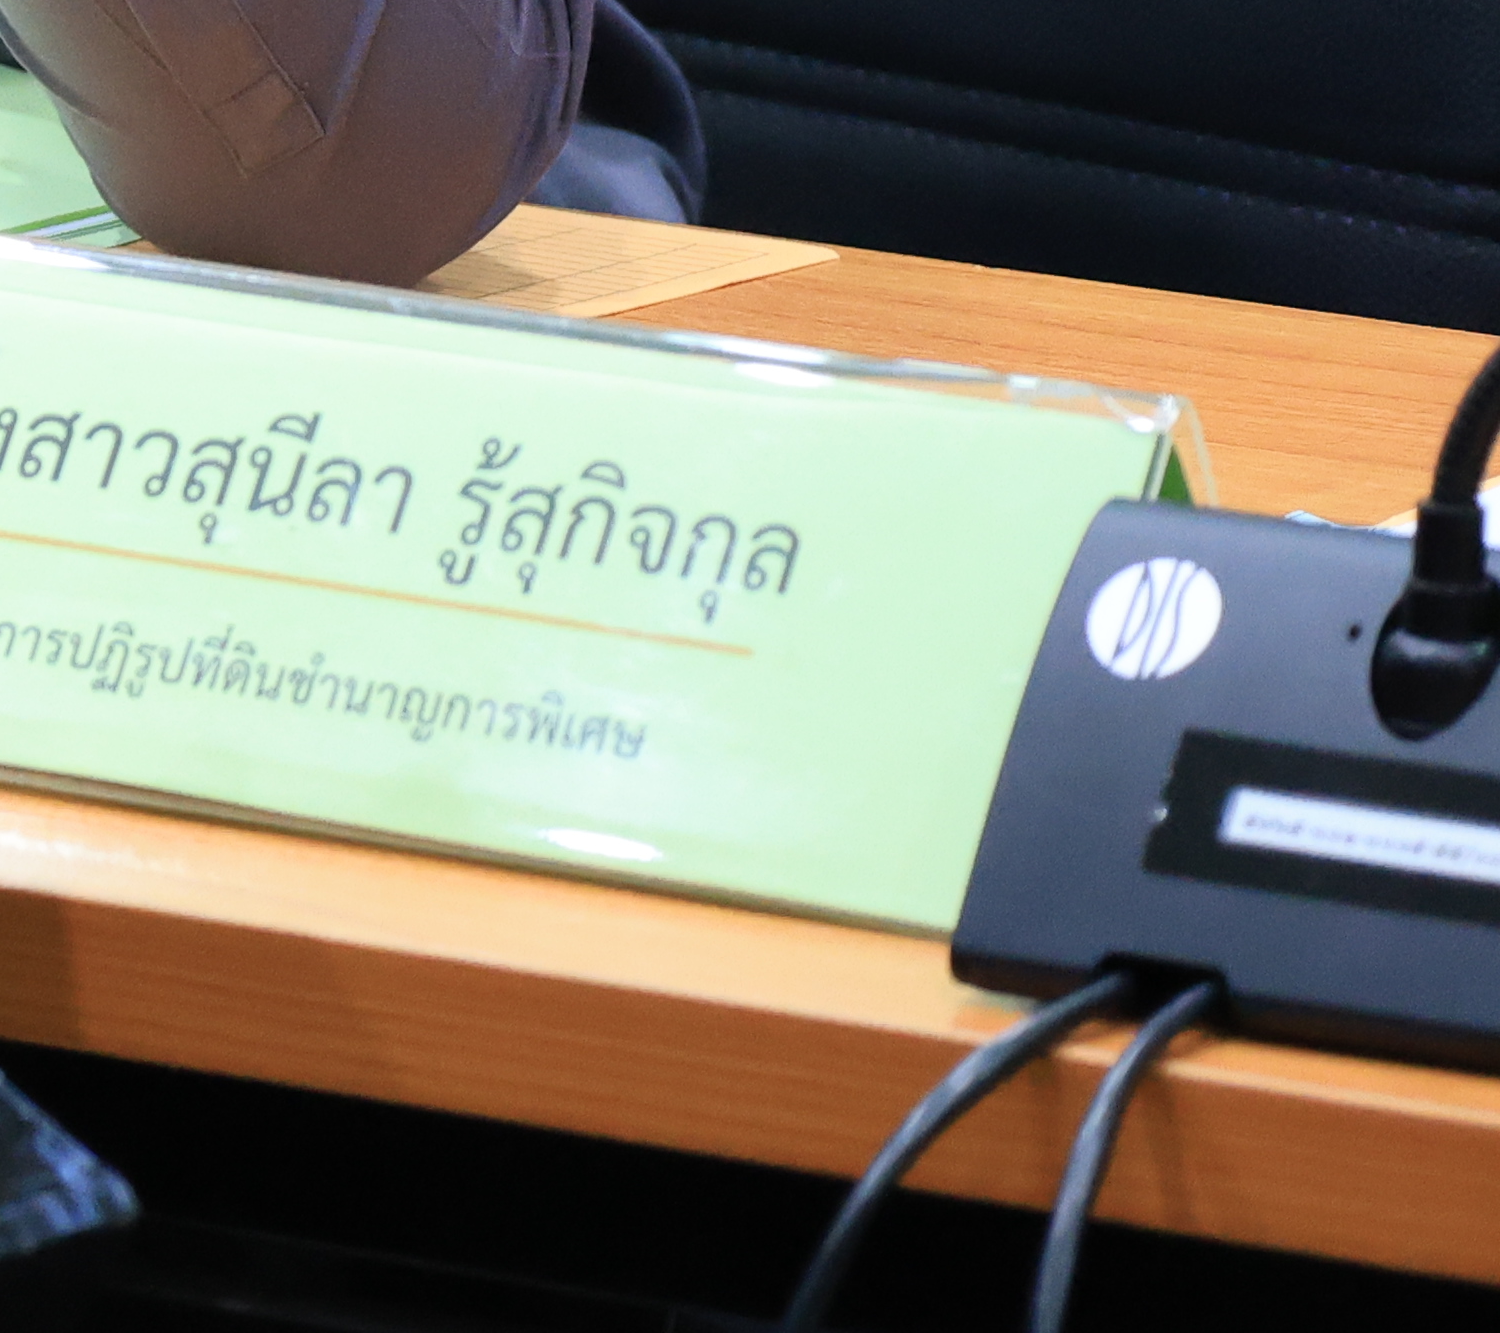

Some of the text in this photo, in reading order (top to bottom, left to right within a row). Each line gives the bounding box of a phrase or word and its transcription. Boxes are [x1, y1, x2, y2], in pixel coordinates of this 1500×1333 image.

[437, 437, 803, 623] รู้สุกิจกุล
